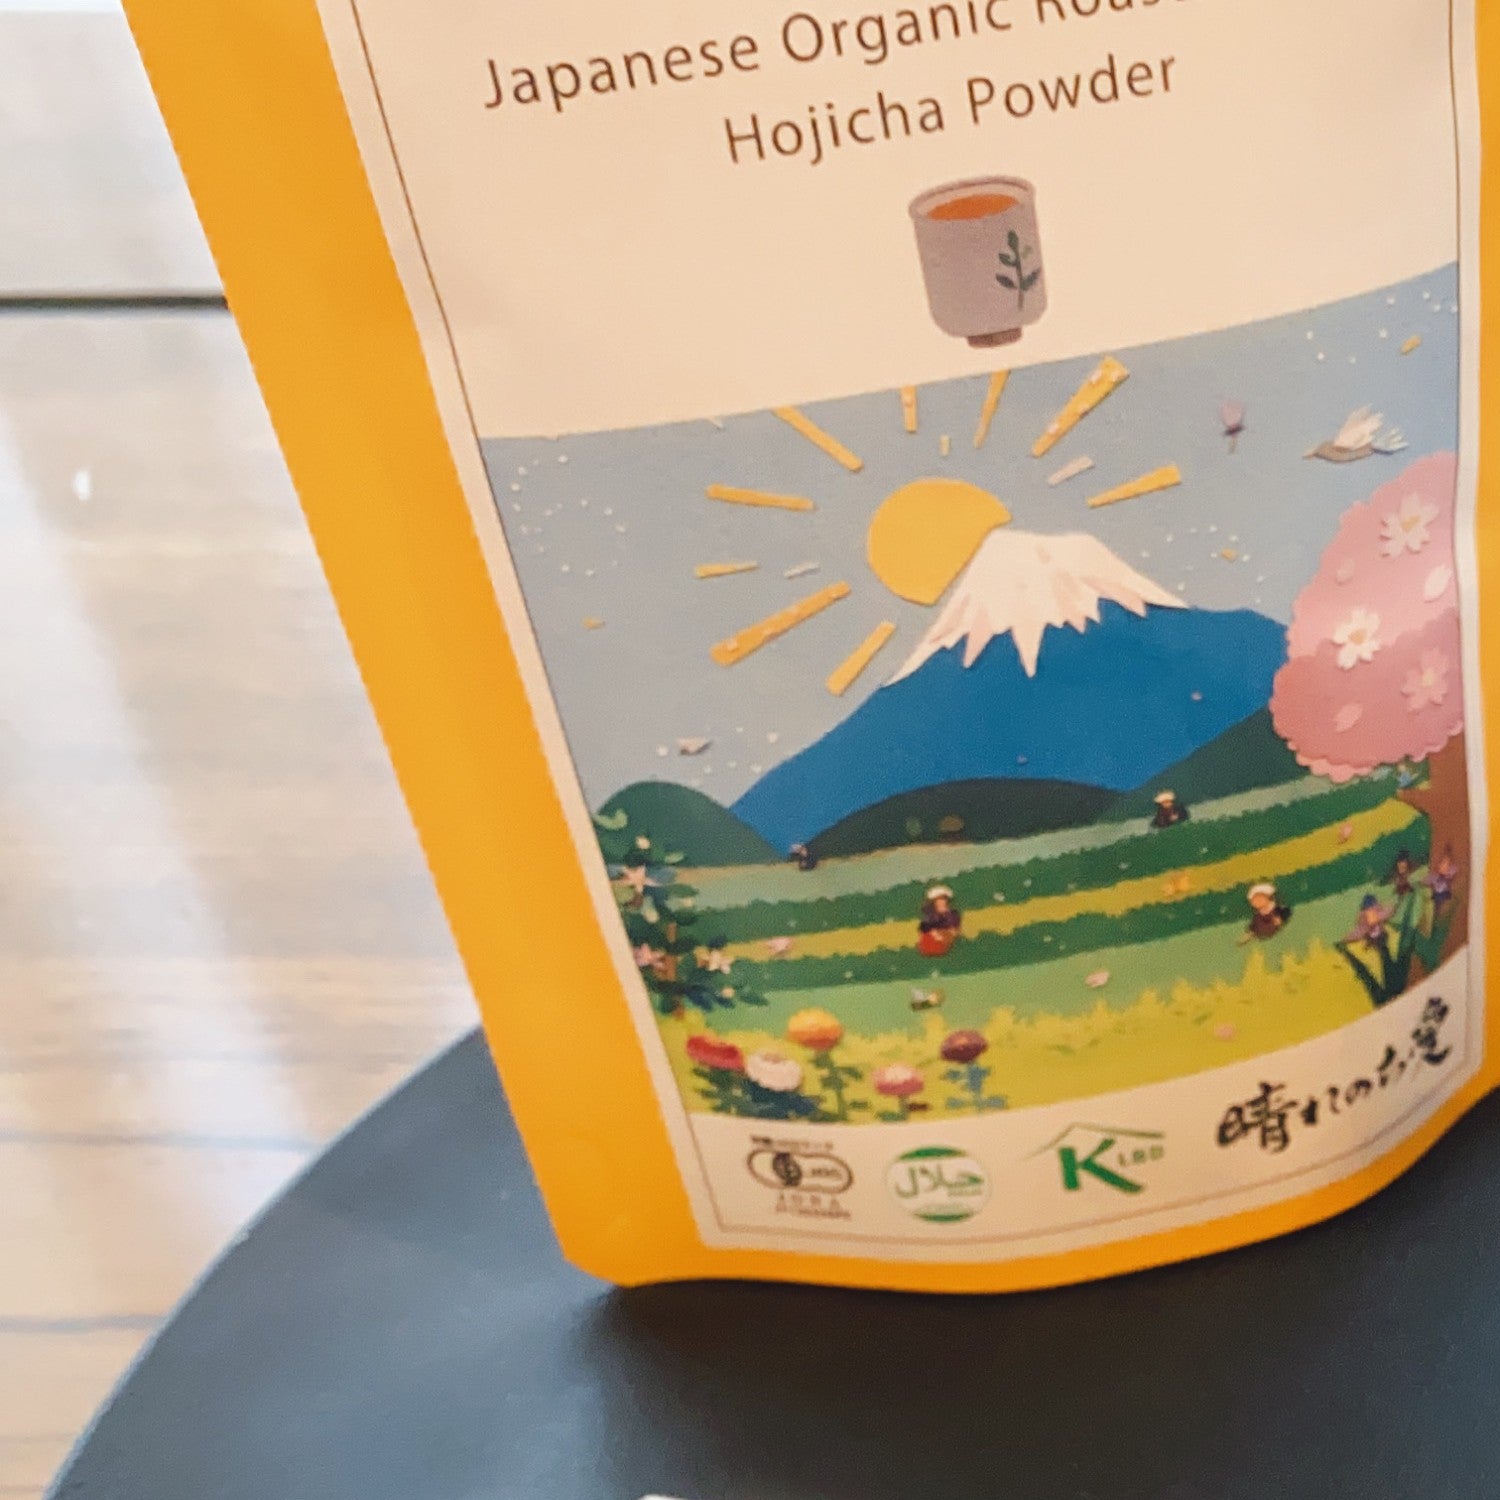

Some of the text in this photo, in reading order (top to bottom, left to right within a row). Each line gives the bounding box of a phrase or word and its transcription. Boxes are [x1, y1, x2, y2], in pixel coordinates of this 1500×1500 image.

[484, 0, 1012, 114] Japanese Organic
[724, 52, 1176, 167] Hojicha Powder
